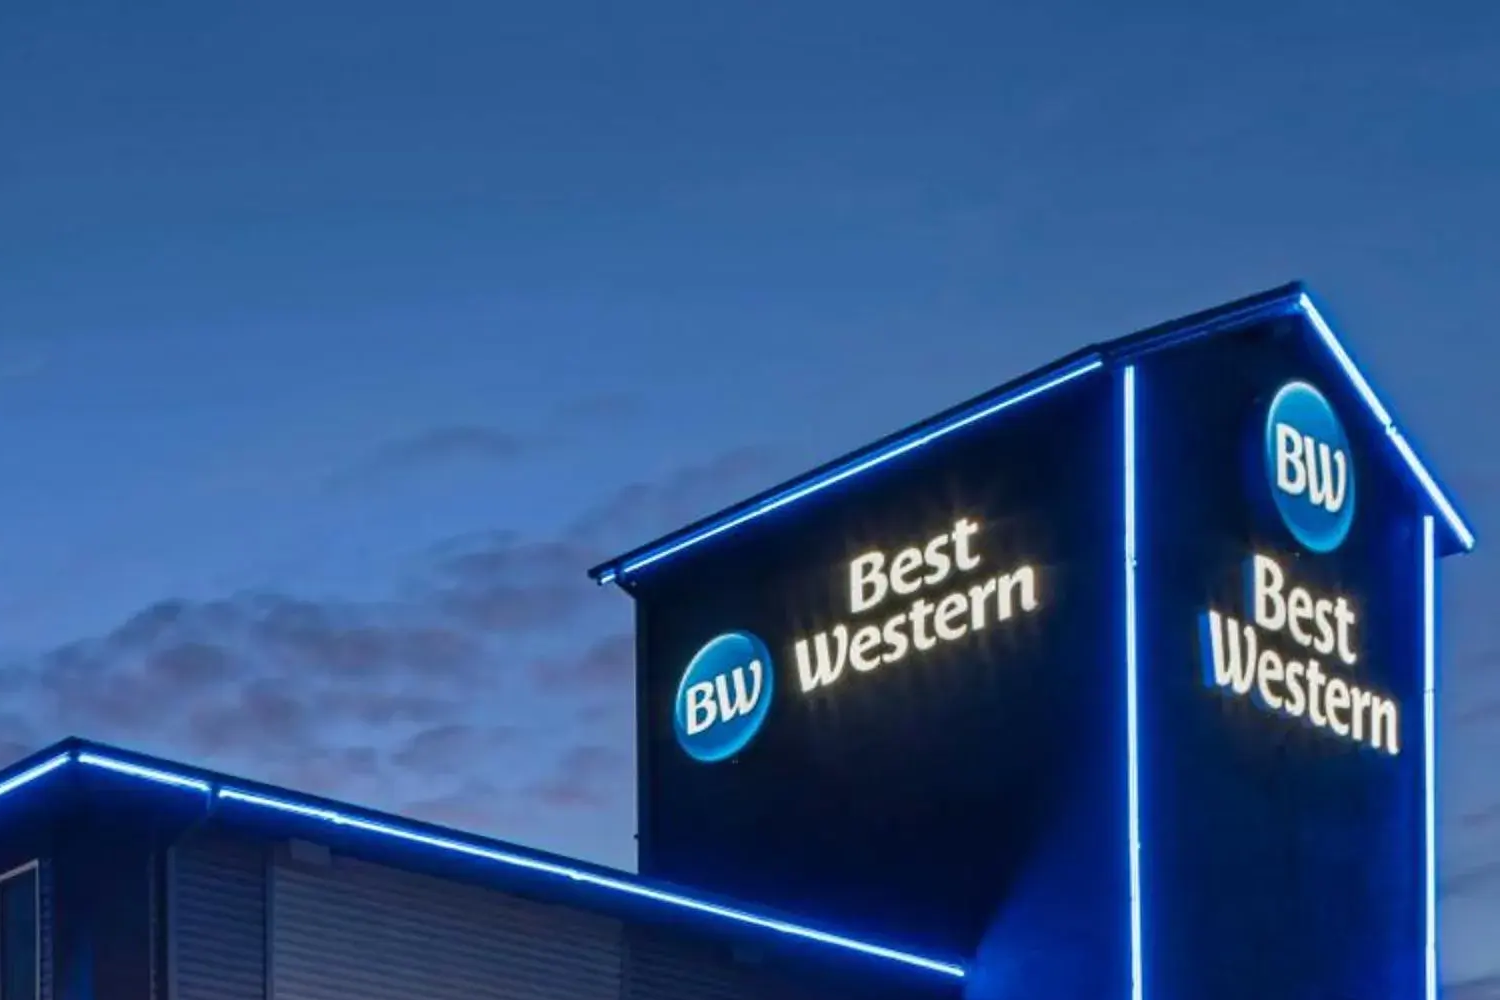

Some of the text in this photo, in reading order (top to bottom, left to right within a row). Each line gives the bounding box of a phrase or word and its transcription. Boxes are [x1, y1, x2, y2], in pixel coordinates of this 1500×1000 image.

[1276, 423, 1346, 512] BW
[849, 517, 981, 614] Best
[1253, 553, 1357, 665] Best
[794, 565, 1038, 693] Western
[686, 660, 763, 735] BW
[1208, 609, 1399, 755] Western
